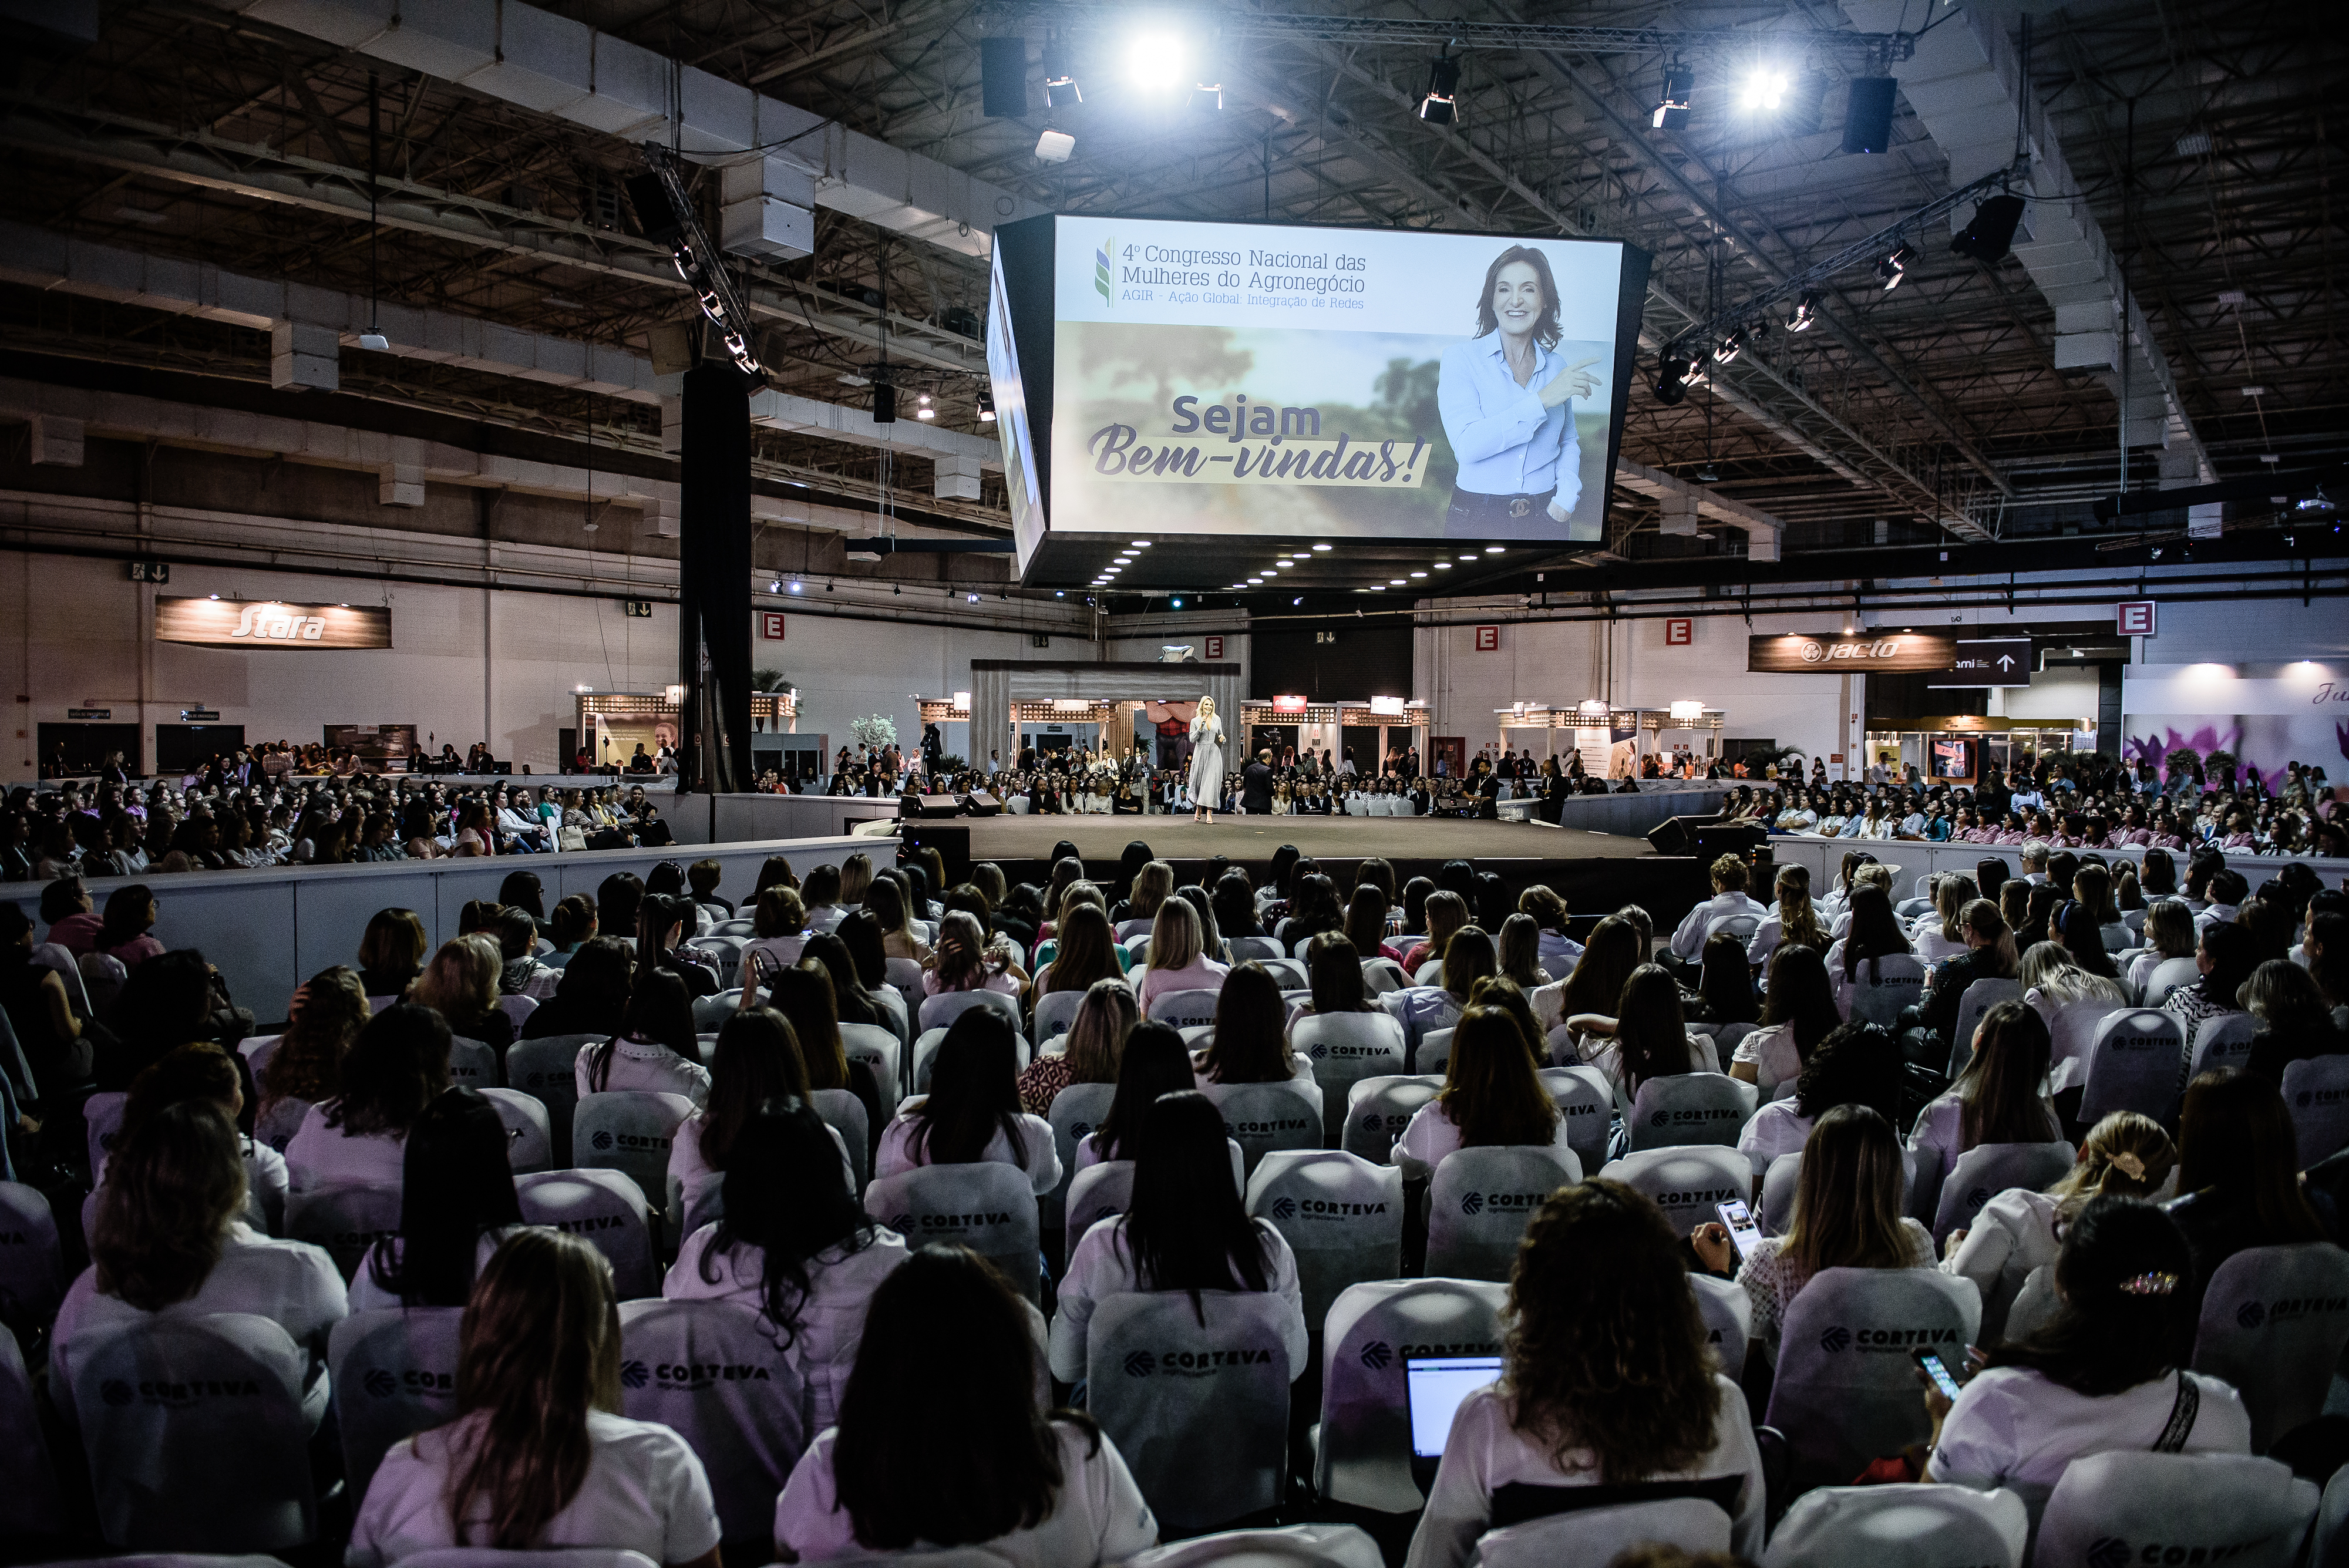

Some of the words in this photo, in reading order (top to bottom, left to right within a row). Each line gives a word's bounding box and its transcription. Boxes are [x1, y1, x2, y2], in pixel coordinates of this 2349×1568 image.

[1145, 244, 1241, 267] Congresso
[1249, 249, 1329, 270] Nacional
[1335, 254, 1366, 271] das
[1122, 265, 1210, 286] Mulheres
[1218, 270, 1240, 288] do
[1248, 271, 1365, 295] Agronegócio
[1122, 290, 1153, 301] AGIR
[1168, 291, 1199, 305] Ação
[1203, 292, 1242, 306] Global:
[1247, 294, 1307, 308] Integração
[1312, 296, 1325, 308] de
[1330, 297, 1364, 309] Redes
[1171, 393, 1321, 443] Sejam
[1086, 422, 1426, 483] Bem-vindas!
[231, 605, 326, 640] Stara
[768, 617, 780, 636] E
[2125, 607, 2146, 630] E
[1480, 629, 1494, 648] E
[1671, 622, 1687, 642] E
[1208, 640, 1220, 656] E
[1821, 640, 1900, 662] jacto
[2313, 682, 2349, 704] Ju
[1182, 1018, 1214, 1026] CORT
[1331, 1046, 1391, 1056] CORTEVA
[2129, 1037, 2178, 1047] CORTEVA
[1563, 1104, 1596, 1116] TEVA
[1674, 1109, 1739, 1121] CORTEVA
[1238, 1118, 1307, 1133] CORTEVA
[617, 1134, 669, 1149] CORTE
[1488, 1194, 1544, 1207] CORTE
[1657, 1187, 1737, 1205] CORTEVA
[1301, 1199, 1386, 1216] CORTEVA
[557, 1214, 625, 1233] RTEVA
[921, 1213, 1011, 1228] CORTEVA
[1301, 1213, 1345, 1222] agriscience
[1856, 1328, 1957, 1347] CORTEVA
[1399, 1342, 1502, 1356] CORTEV
[1162, 1350, 1272, 1370] CORTEVA
[655, 1363, 770, 1383] CORTEVA
[139, 1380, 260, 1400] CORTEVA
